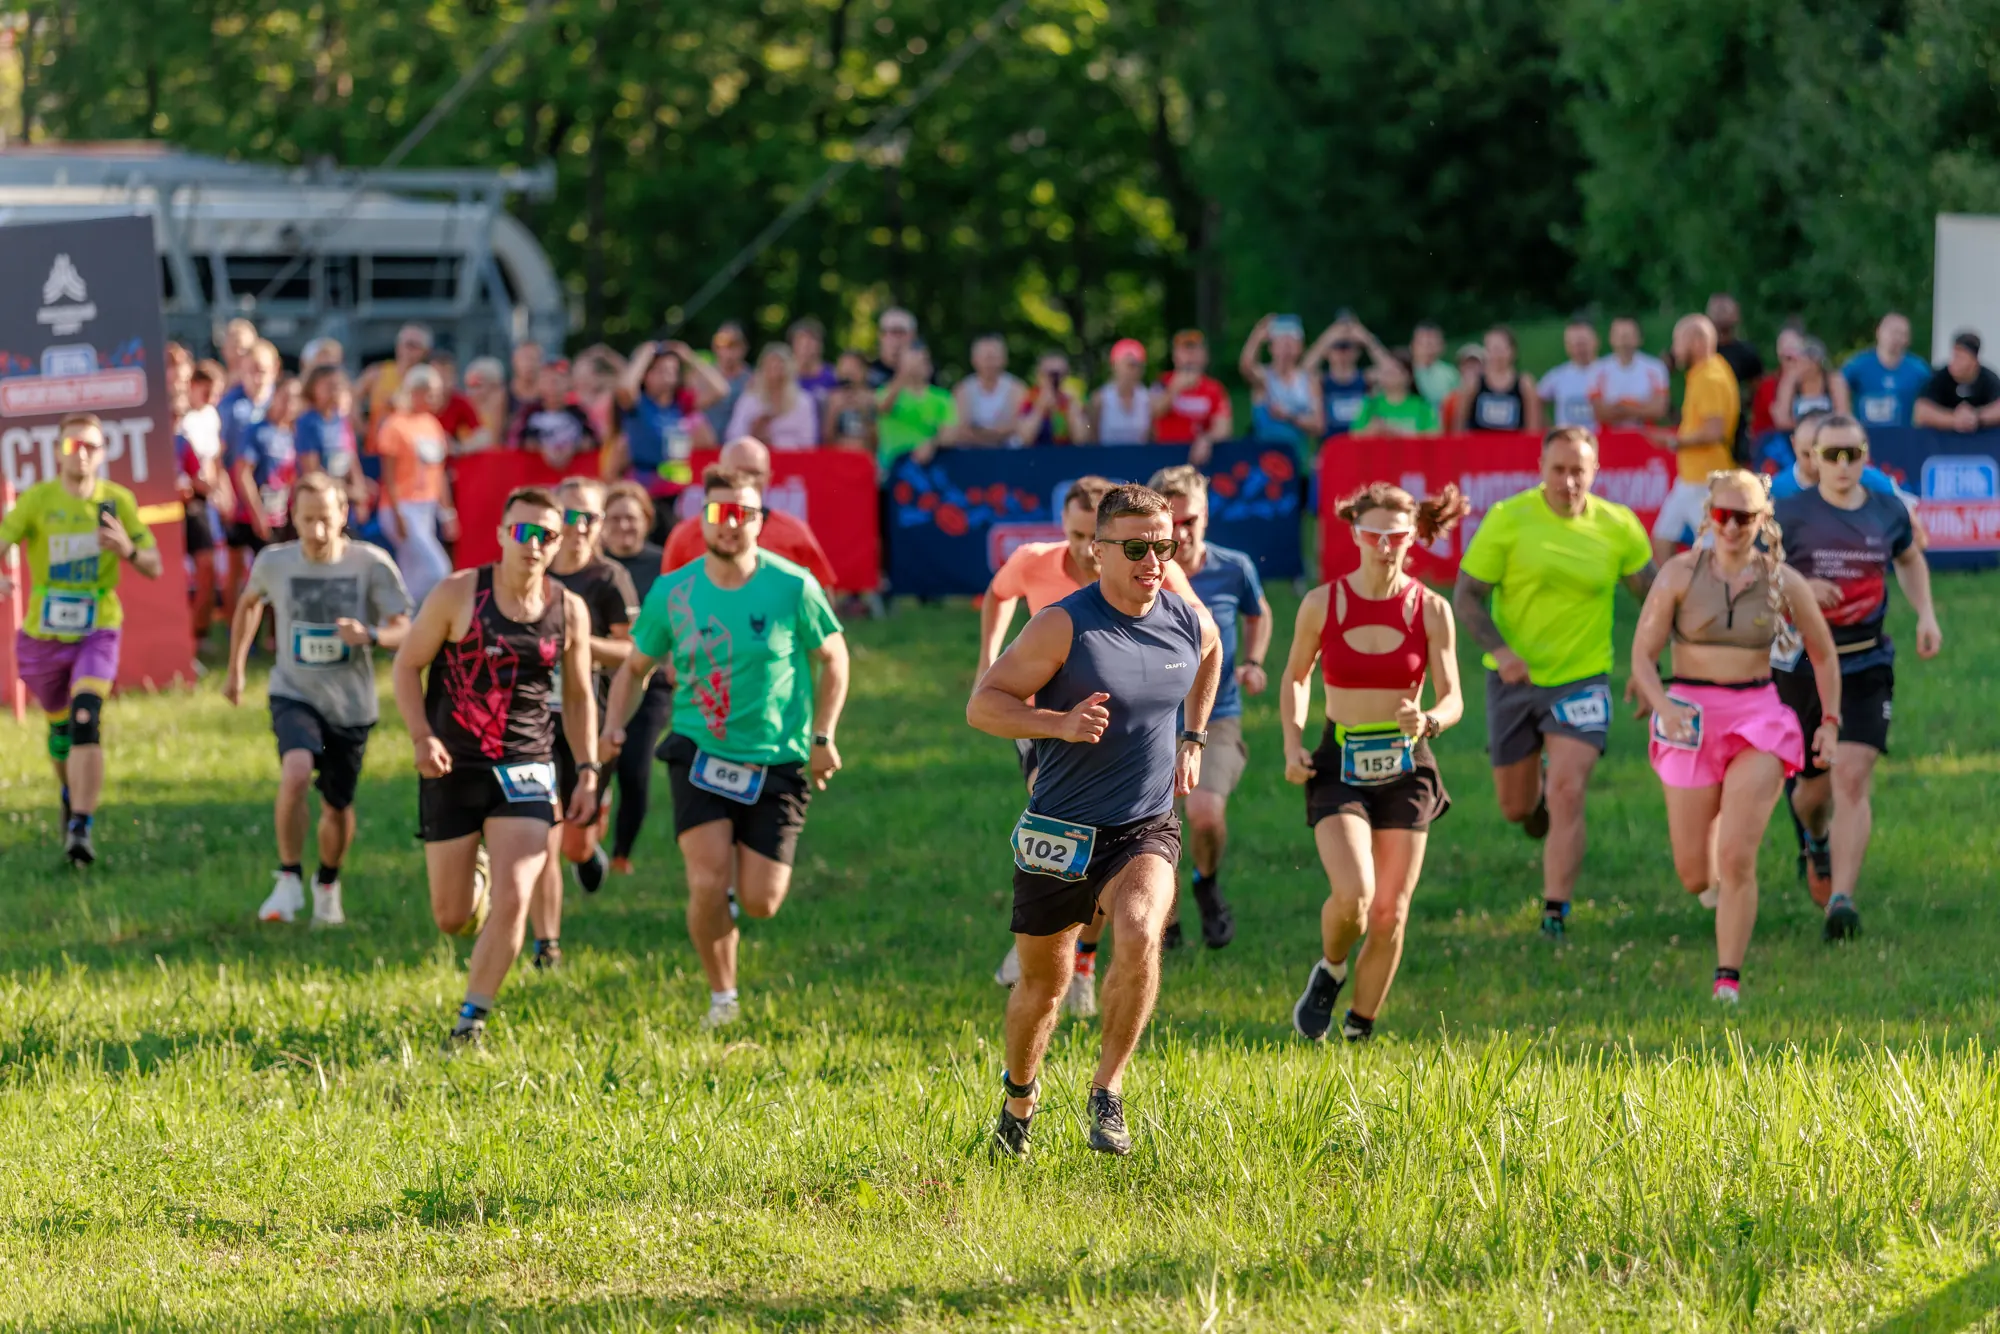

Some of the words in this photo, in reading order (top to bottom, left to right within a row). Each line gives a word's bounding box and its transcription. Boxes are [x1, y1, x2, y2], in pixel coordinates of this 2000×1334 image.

[1, 415, 155, 491] СТРТ
[1361, 755, 1396, 772] 153
[715, 766, 740, 785] 66
[1024, 836, 1068, 864] 102
